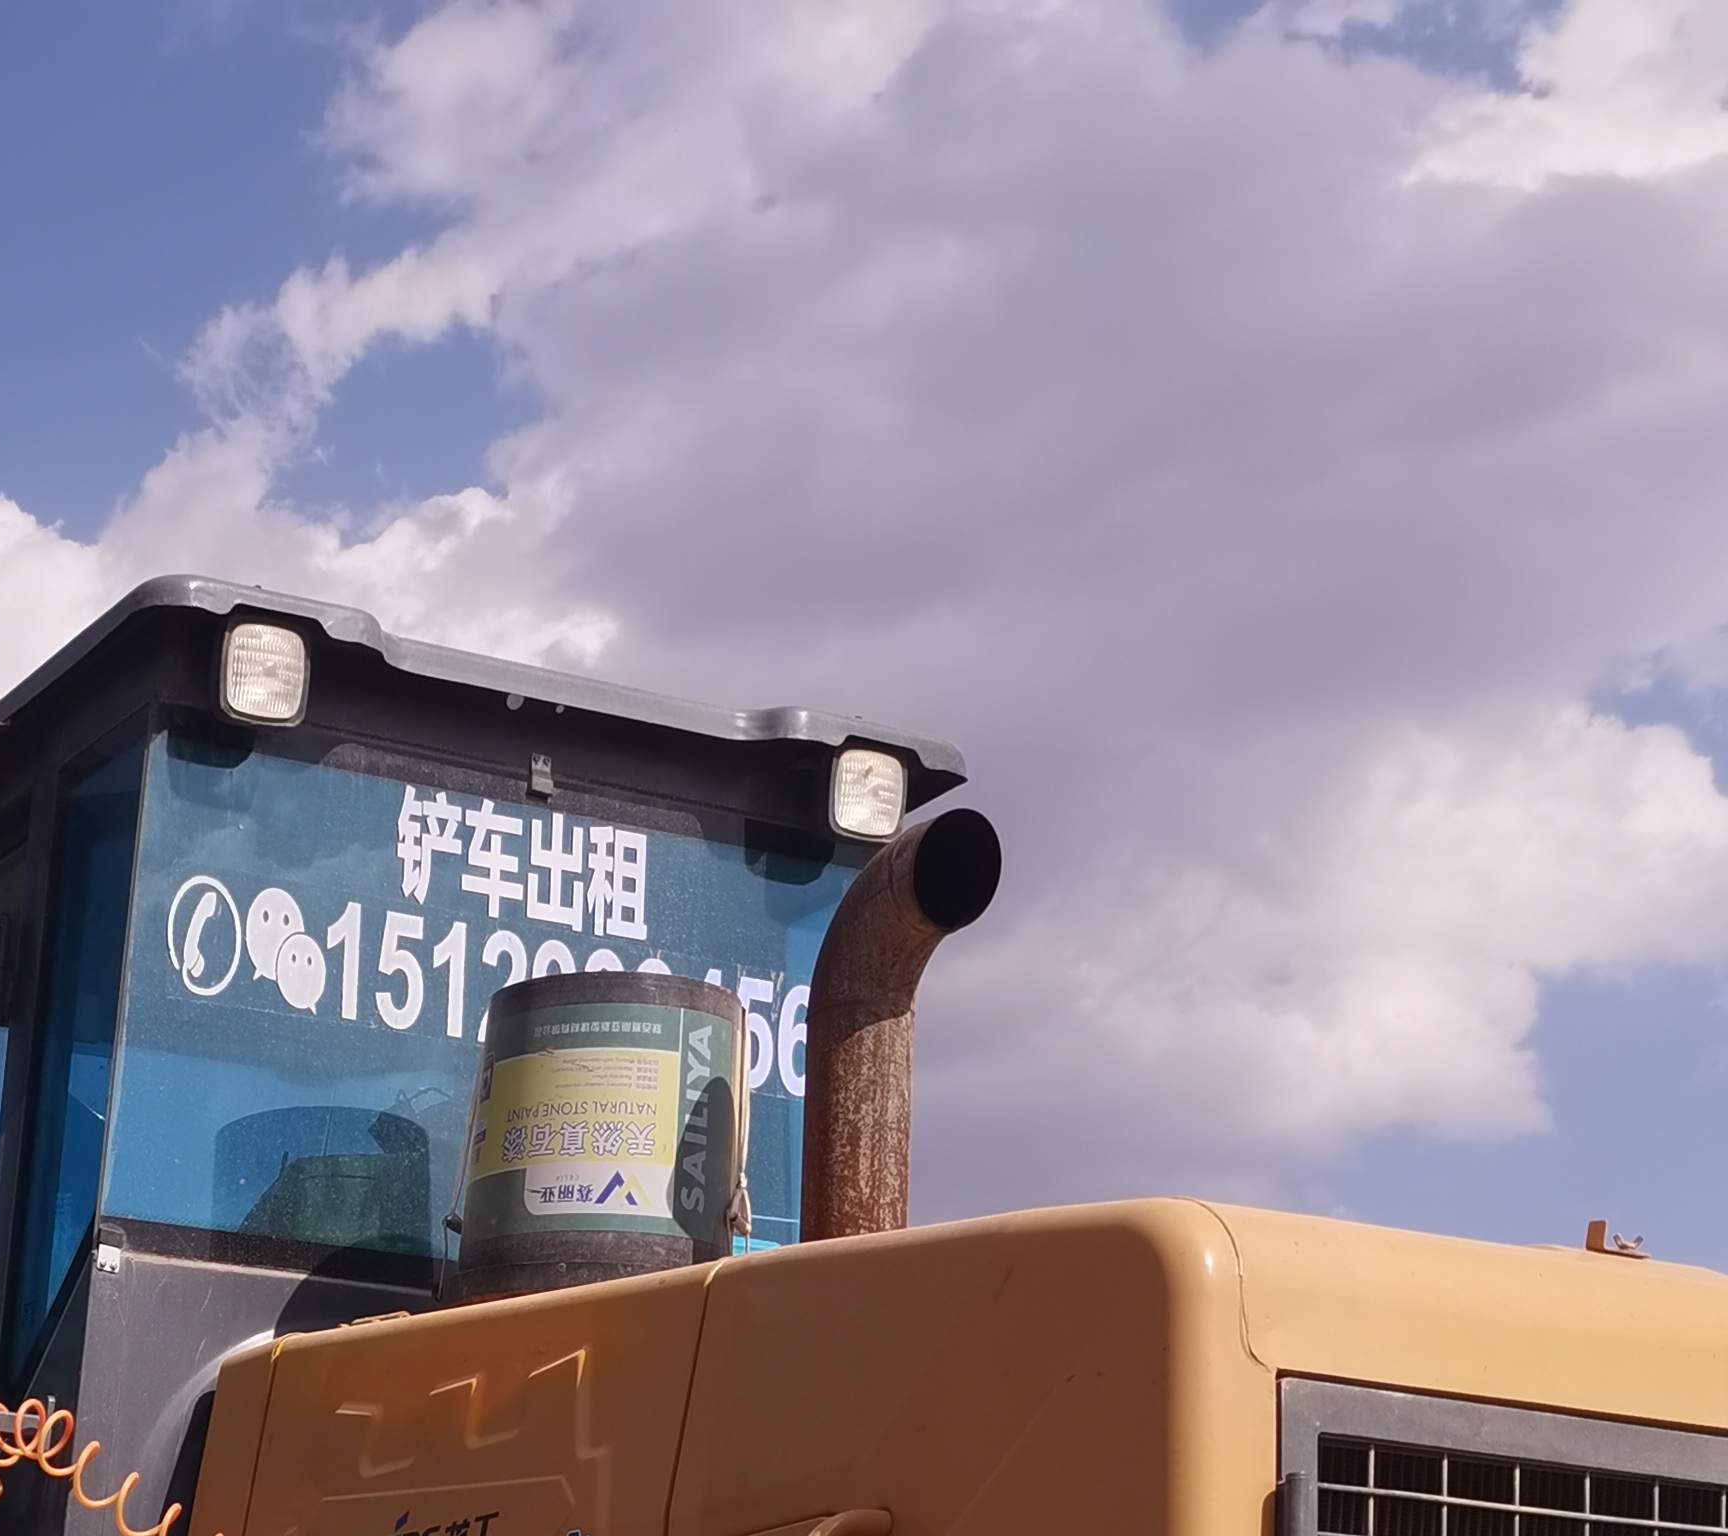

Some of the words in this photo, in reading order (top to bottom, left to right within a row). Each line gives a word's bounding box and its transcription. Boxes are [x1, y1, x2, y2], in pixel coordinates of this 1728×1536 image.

[397, 785, 648, 941] 铲车出租
[505, 1105, 540, 1122] PAINT
[542, 1102, 588, 1118] STONE
[592, 1101, 658, 1116] NATURAL
[679, 1024, 714, 1214] SAILIYA
[501, 1120, 657, 1164] 天然真石漆
[539, 1184, 595, 1205] 赛丽亚
